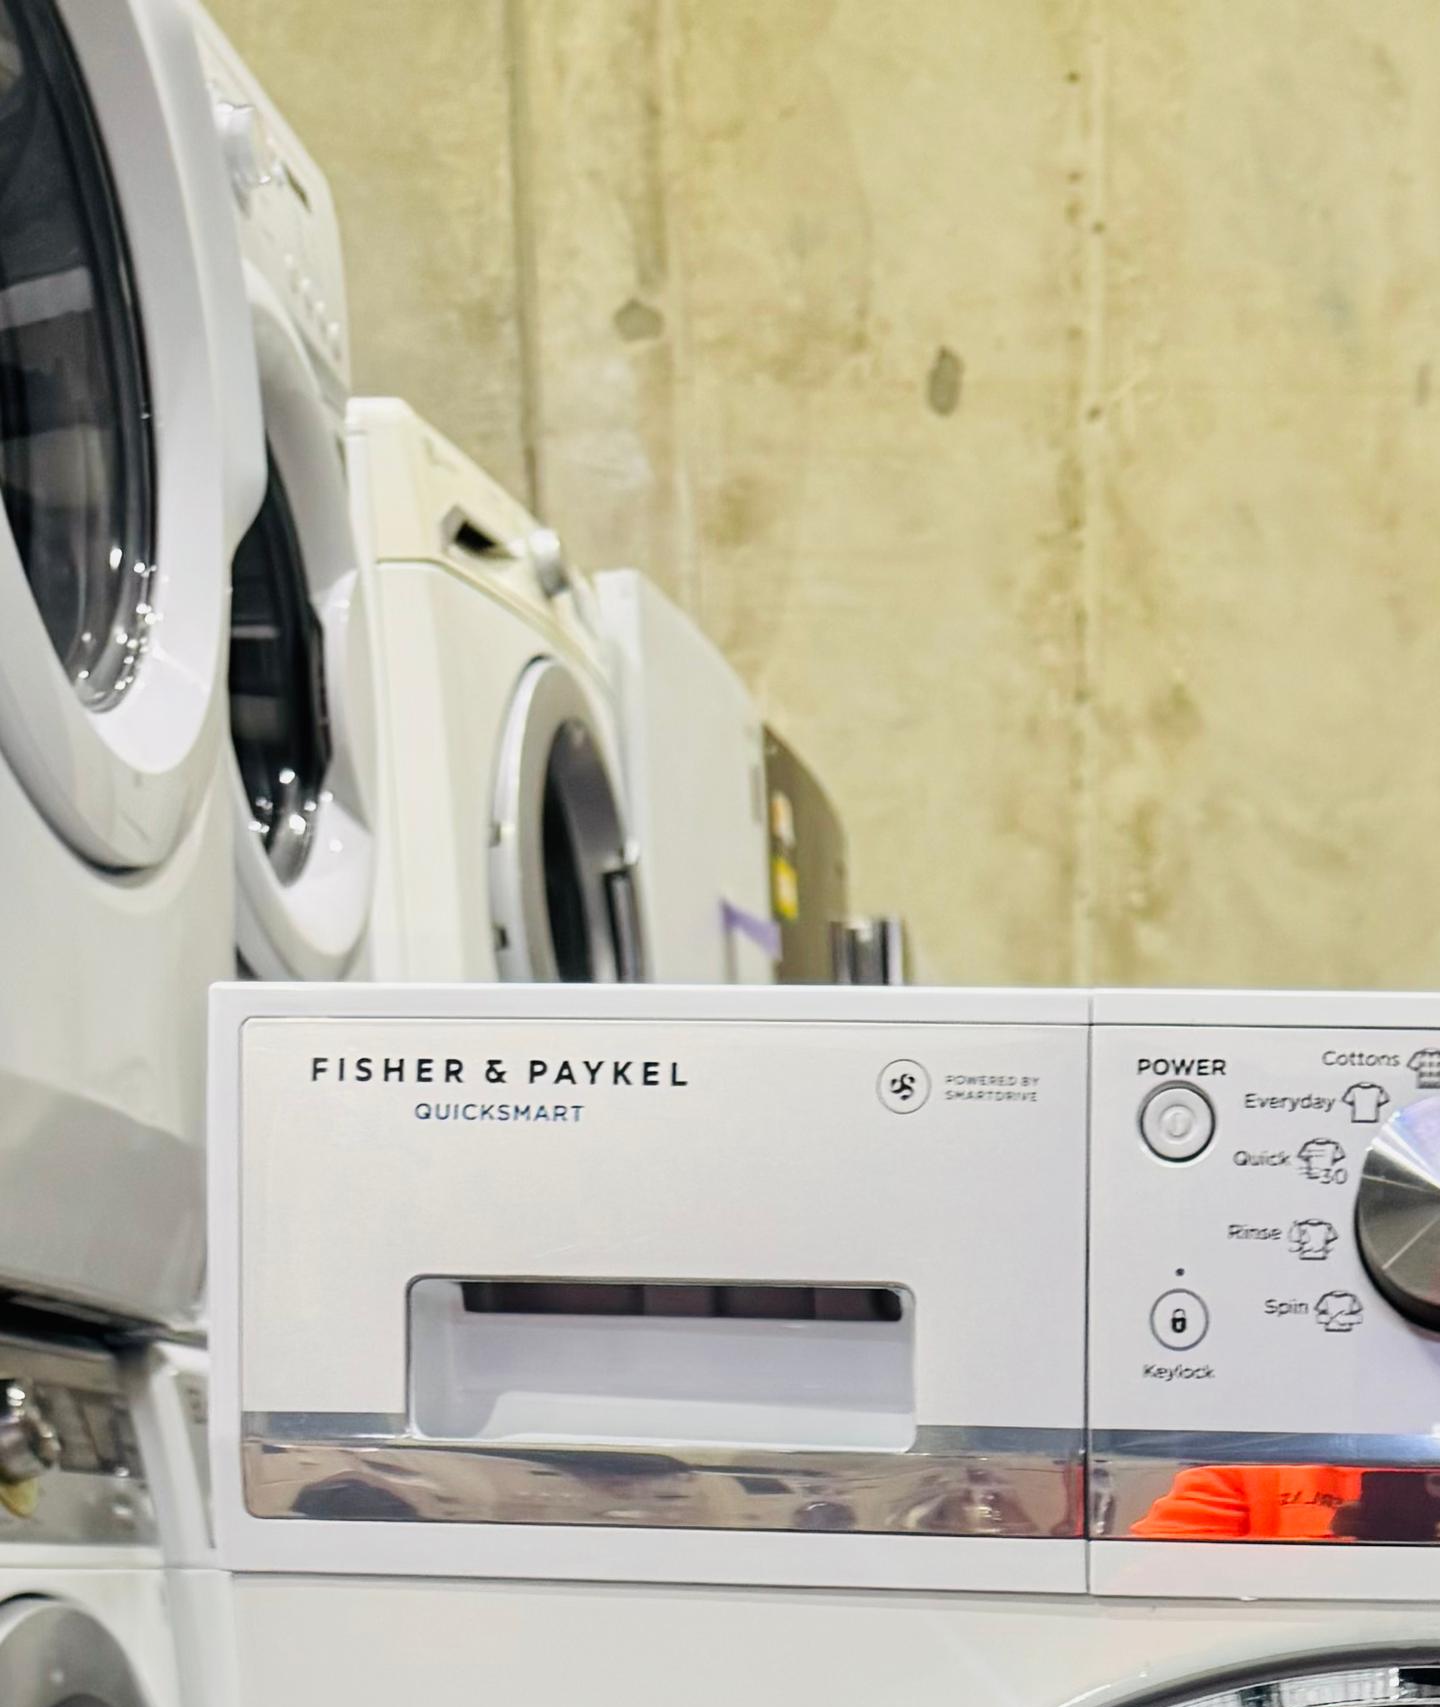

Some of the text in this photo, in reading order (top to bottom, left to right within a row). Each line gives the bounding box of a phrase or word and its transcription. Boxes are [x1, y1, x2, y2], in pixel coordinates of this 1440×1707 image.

[1137, 1058, 1226, 1075] POWER
[1321, 1050, 1400, 1067] Cottons
[311, 1057, 689, 1086] FISHER & PAYKEL
[945, 1075, 1040, 1087] POWERED BY
[945, 1090, 1038, 1102] SMARTDRIVE
[1244, 1093, 1336, 1112] Everyday
[415, 1103, 584, 1122] QUICKSMART
[1233, 1150, 1291, 1166] Quick
[1319, 1168, 1348, 1184] 30
[1228, 1224, 1282, 1240] Rinse
[1264, 1299, 1309, 1317] Spin
[1143, 1364, 1215, 1381] Keylock
